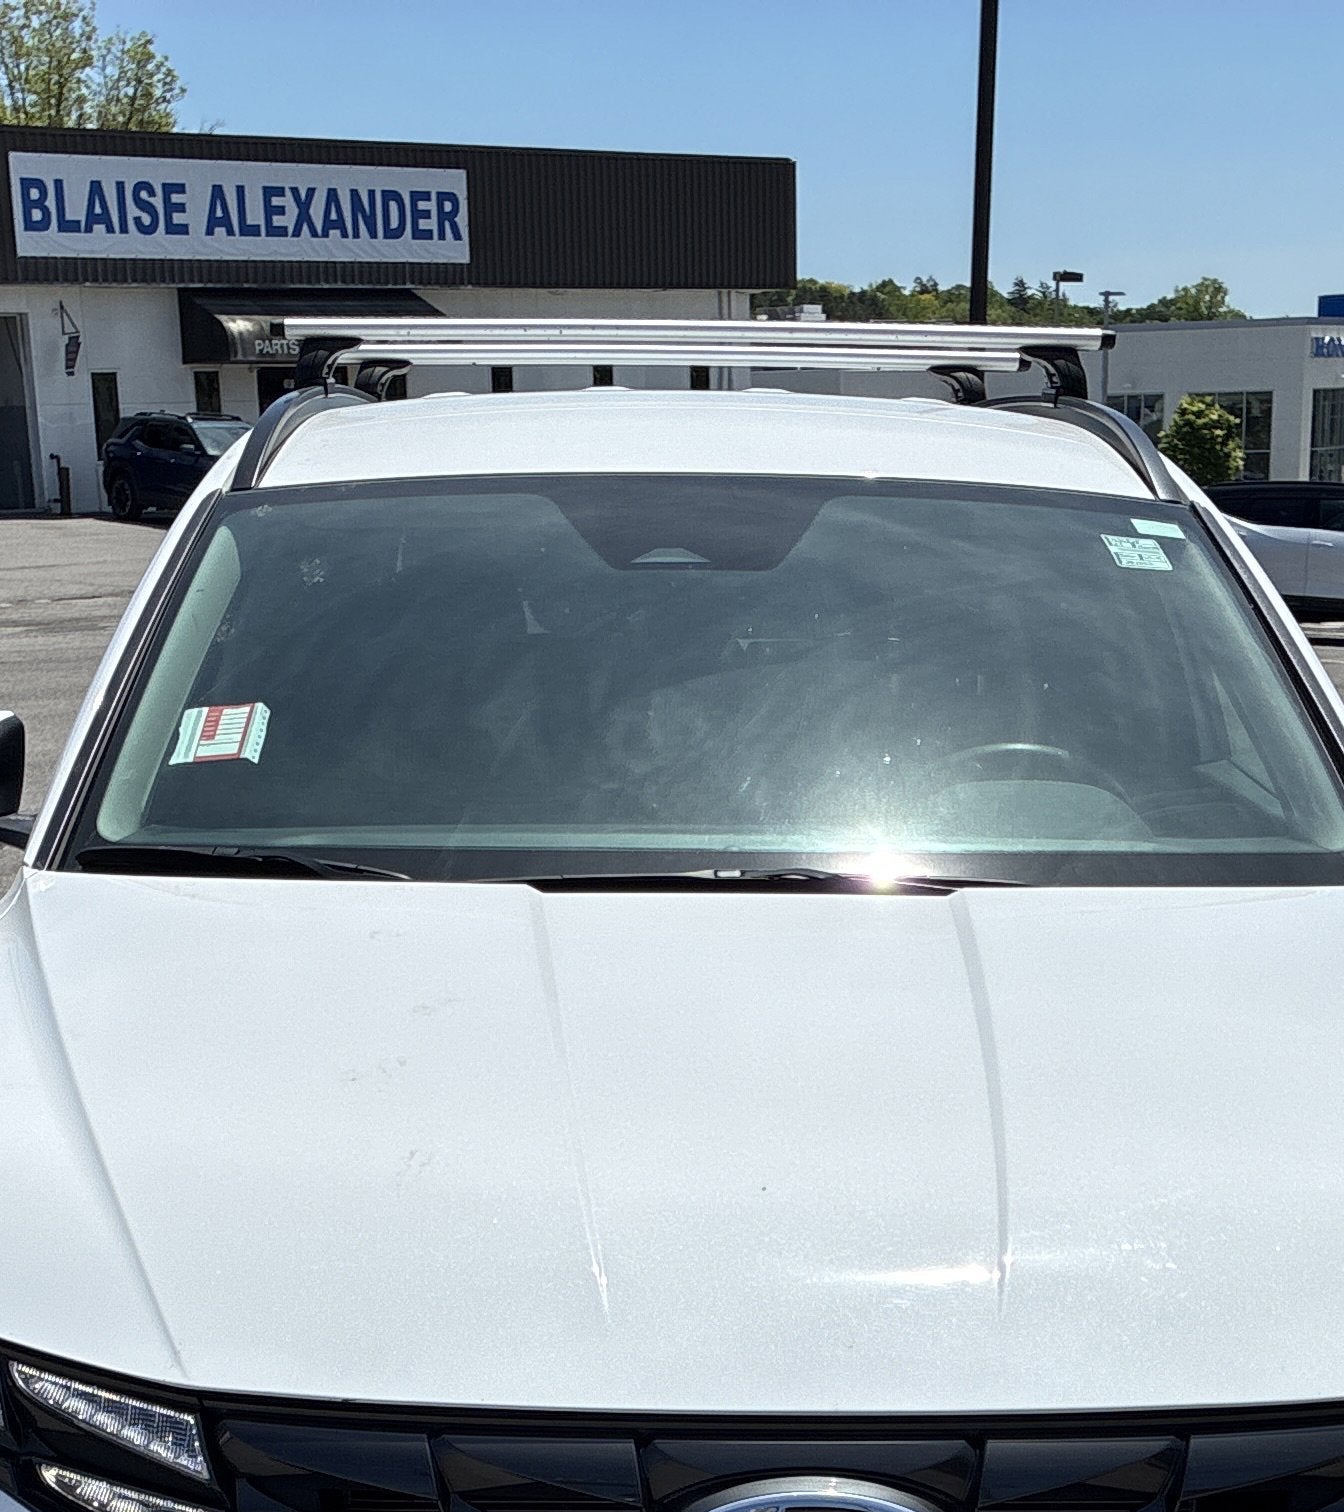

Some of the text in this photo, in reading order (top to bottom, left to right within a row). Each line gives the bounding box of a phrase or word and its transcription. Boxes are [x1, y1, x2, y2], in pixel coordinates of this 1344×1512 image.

[19, 177, 463, 242] BLAISE ALEXANDER
[255, 339, 300, 355] PARTS
